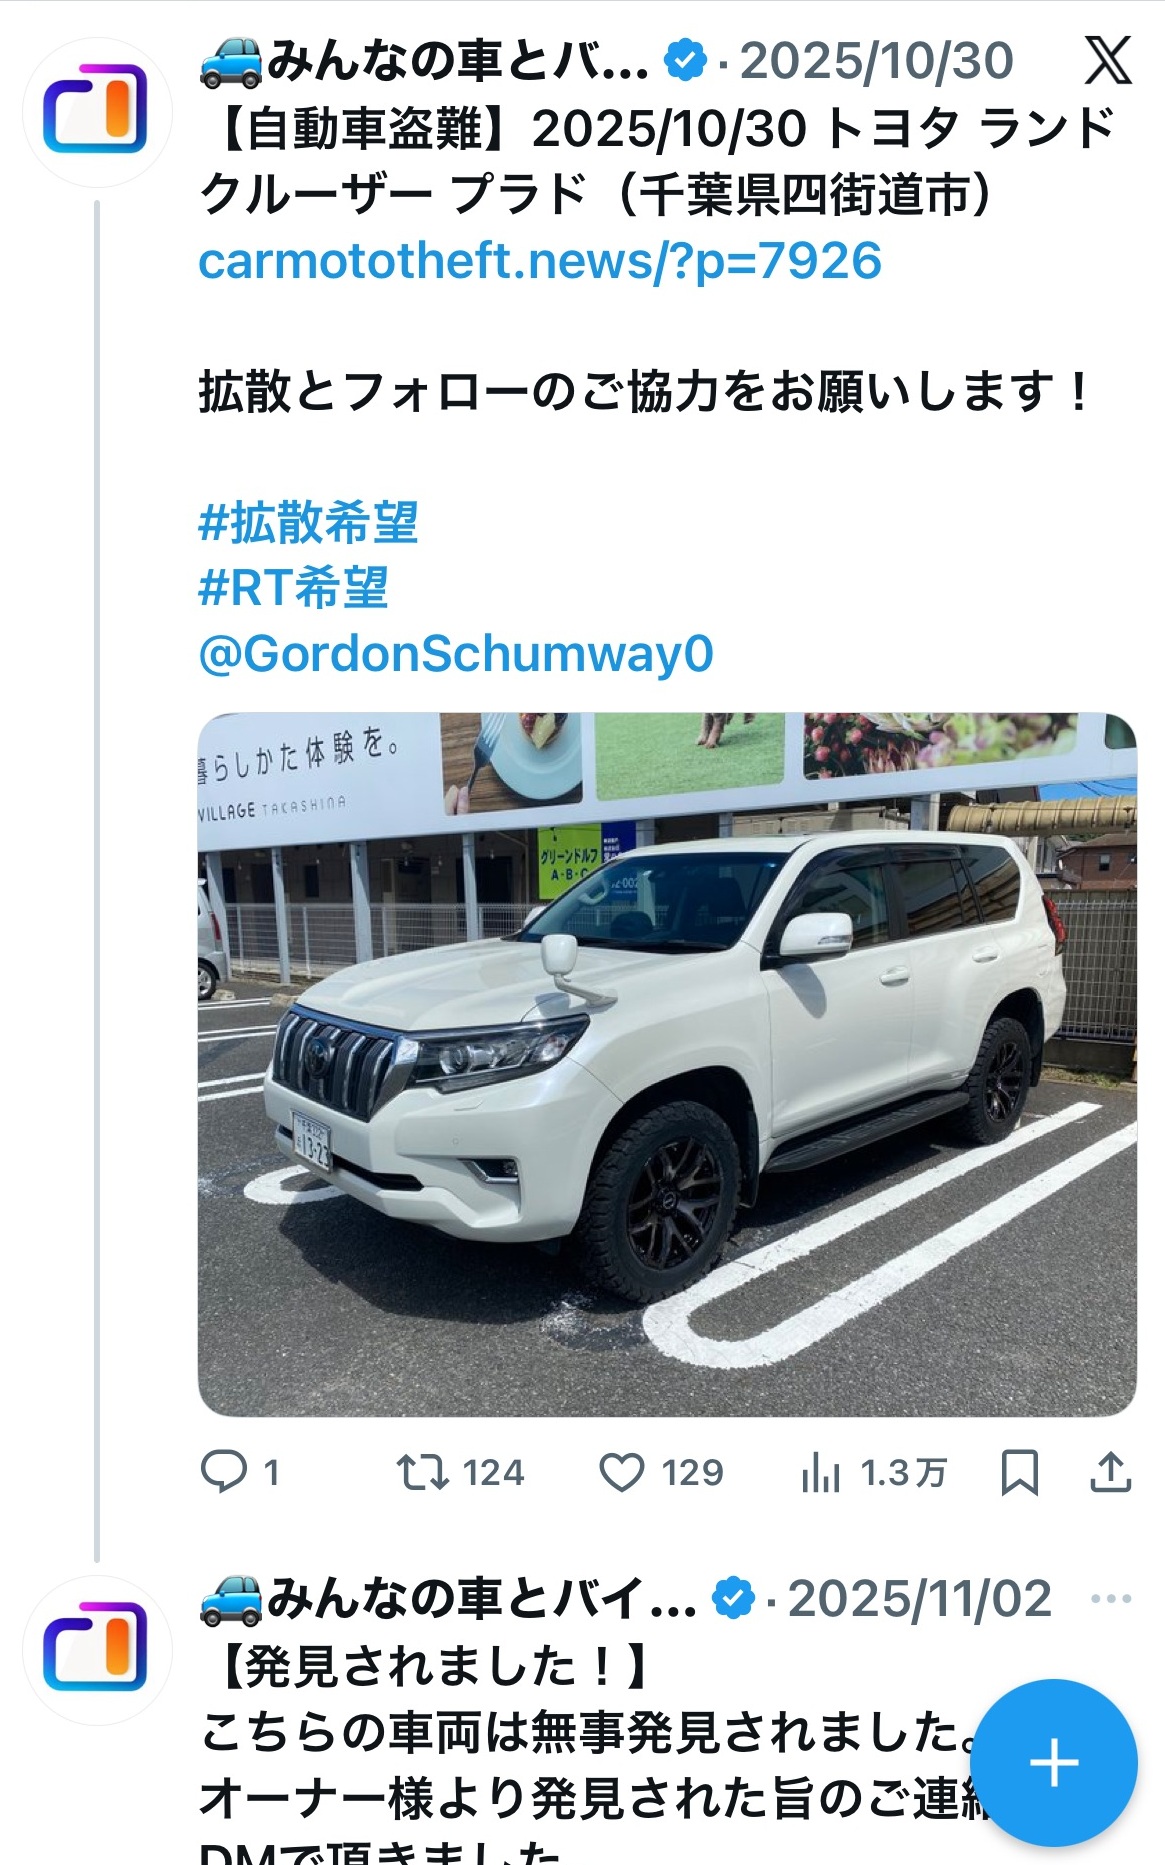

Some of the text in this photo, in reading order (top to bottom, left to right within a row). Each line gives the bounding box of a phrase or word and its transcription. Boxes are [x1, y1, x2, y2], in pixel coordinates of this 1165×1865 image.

[741, 40, 1014, 83] 2025/10/30
[832, 106, 958, 149] トヨタ
[981, 107, 1113, 148] ランド
[201, 170, 432, 216] クルーザー
[199, 240, 881, 287] carmototheft.news/?p=7926
[199, 368, 1083, 413] 拡散とフォローのご協力をお願いします！
[198, 499, 418, 544] #拡散希望
[198, 564, 387, 609] #RT希望
[200, 633, 713, 681] @GordonSchumway0
[265, 1459, 277, 1485] 1
[464, 1459, 524, 1485] 124
[663, 1459, 723, 1486] 129
[789, 1578, 1052, 1620] 2025/11/02
[228, 1643, 643, 1689] 【発見されました！】
